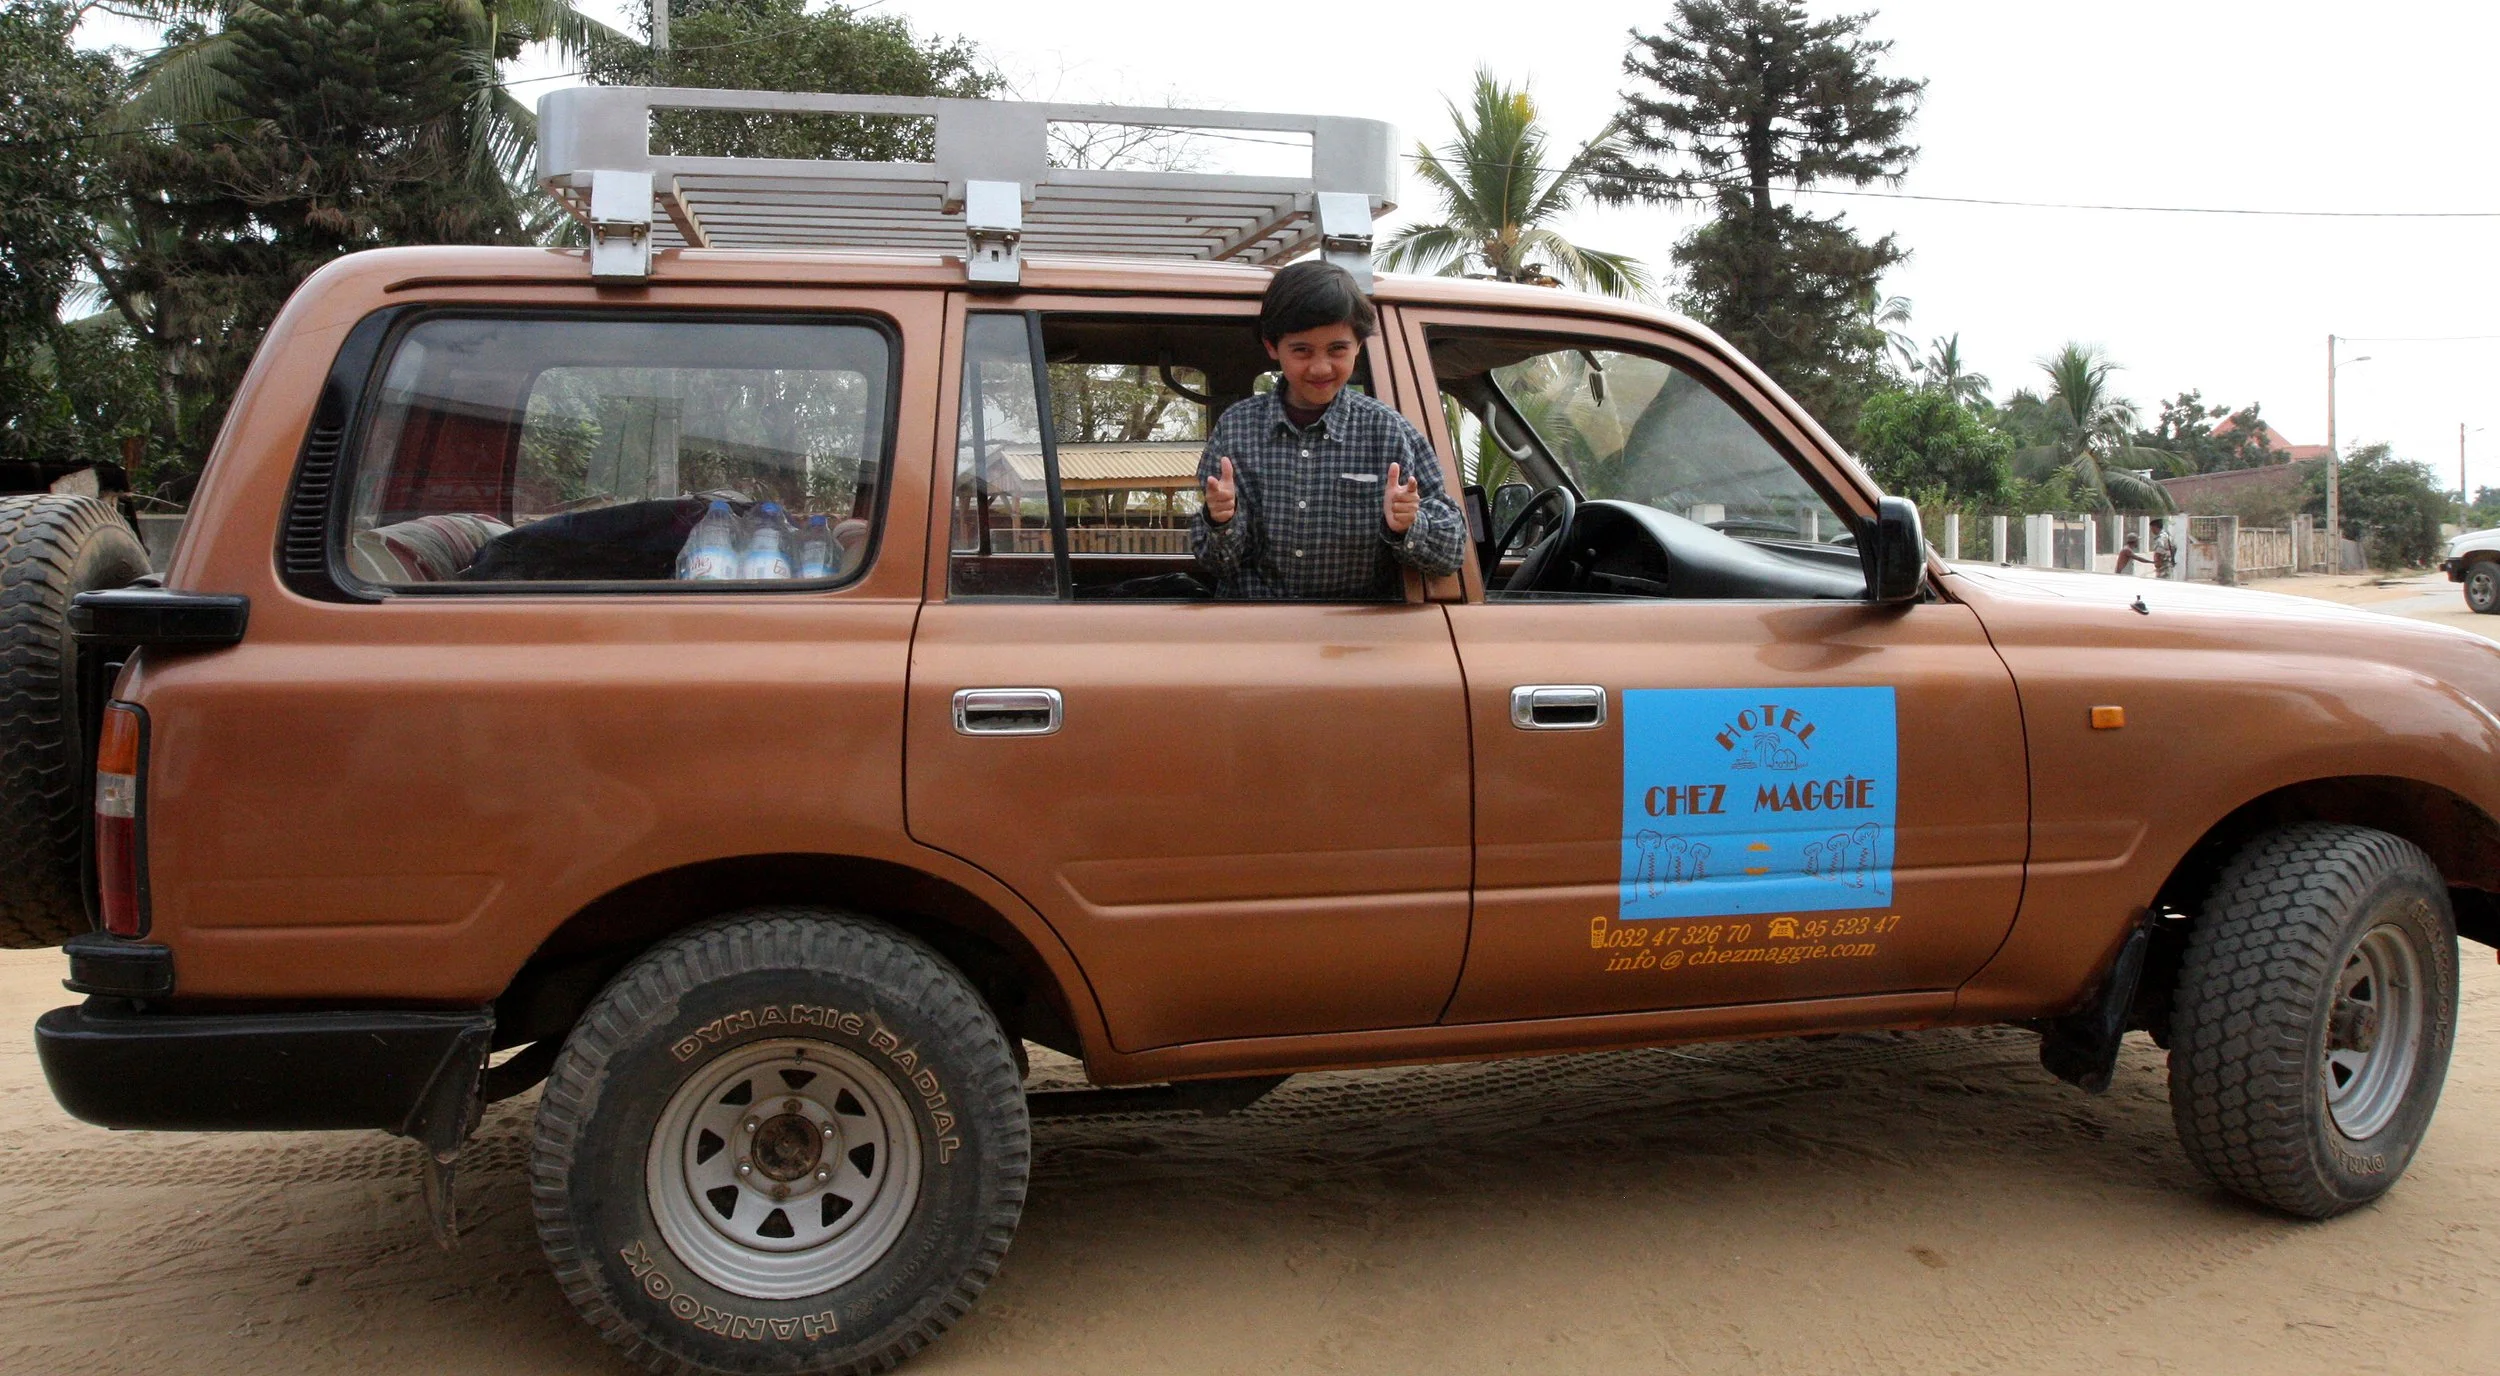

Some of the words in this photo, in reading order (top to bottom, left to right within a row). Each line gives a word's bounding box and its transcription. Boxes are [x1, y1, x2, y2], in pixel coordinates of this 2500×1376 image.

[1714, 705, 1816, 751] HOTEL
[1644, 784, 1727, 816] CHEZ
[1652, 928, 1680, 946] 47
[1682, 925, 1722, 945] 326
[1727, 923, 1751, 943] 70
[1832, 917, 1870, 936] 523
[1873, 915, 1901, 933] 47
[1605, 949, 1656, 972] info
[1660, 950, 1684, 970] @
[1689, 939, 1876, 965] chezmaggie.com
[671, 1005, 862, 1062] DYNAMIC
[868, 1026, 961, 1165] RADIAL
[619, 1241, 838, 1341] HANKOOK
